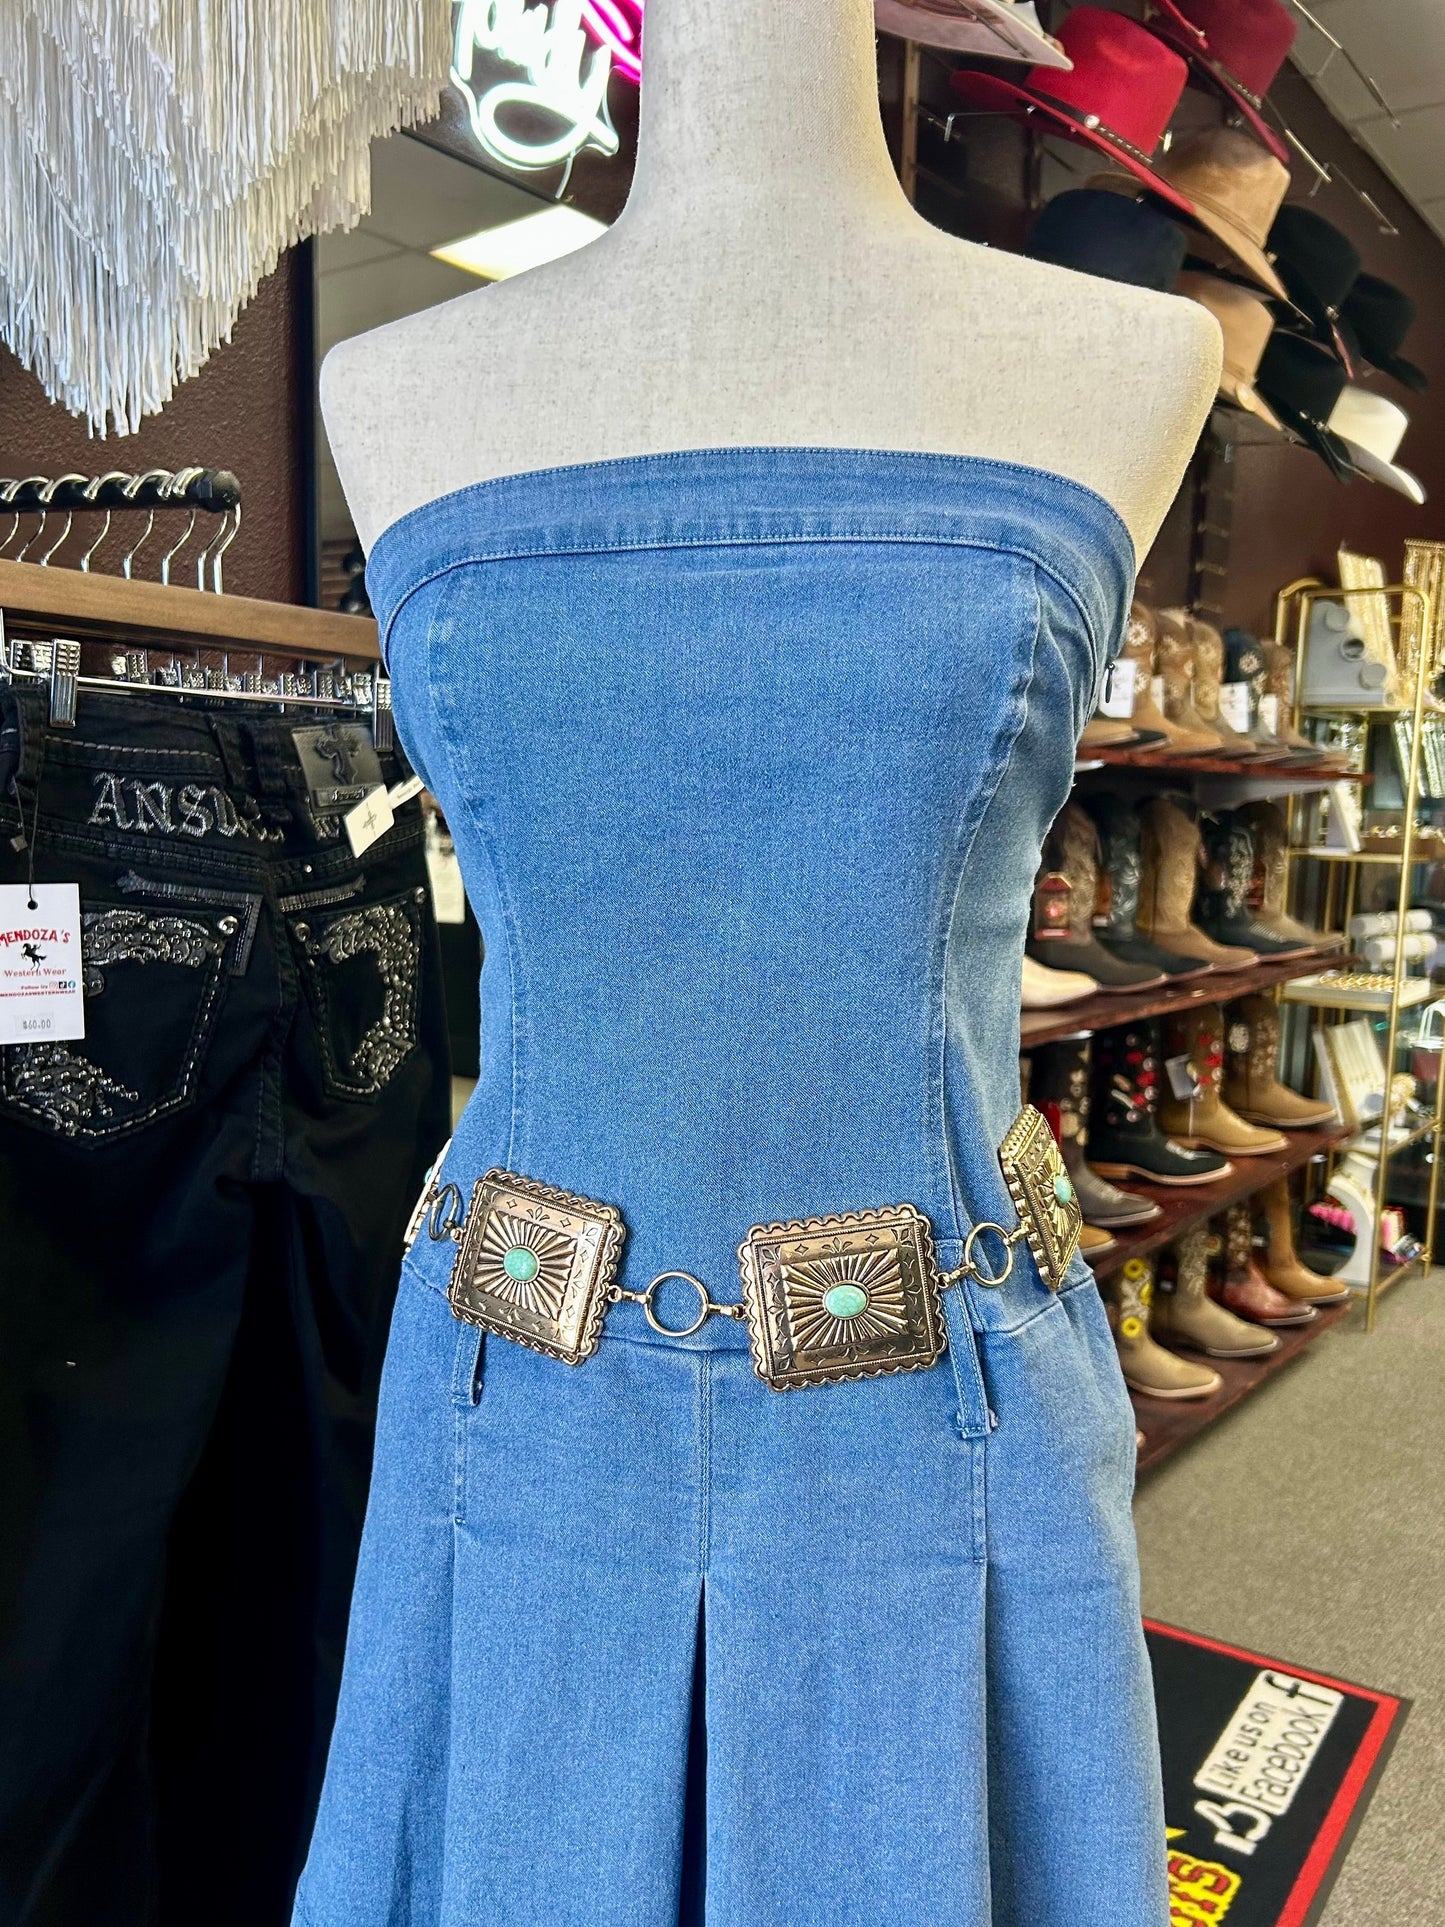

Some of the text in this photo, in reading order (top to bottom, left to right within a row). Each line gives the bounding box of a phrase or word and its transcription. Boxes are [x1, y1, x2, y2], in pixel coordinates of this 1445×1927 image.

[0, 928, 71, 947] MENDOZA'S
[4, 967, 67, 978] Western Wear
[23, 1019, 51, 1030] $60.00
[1239, 1705, 1328, 1809] Facebook
[1204, 1748, 1249, 1789] Like
